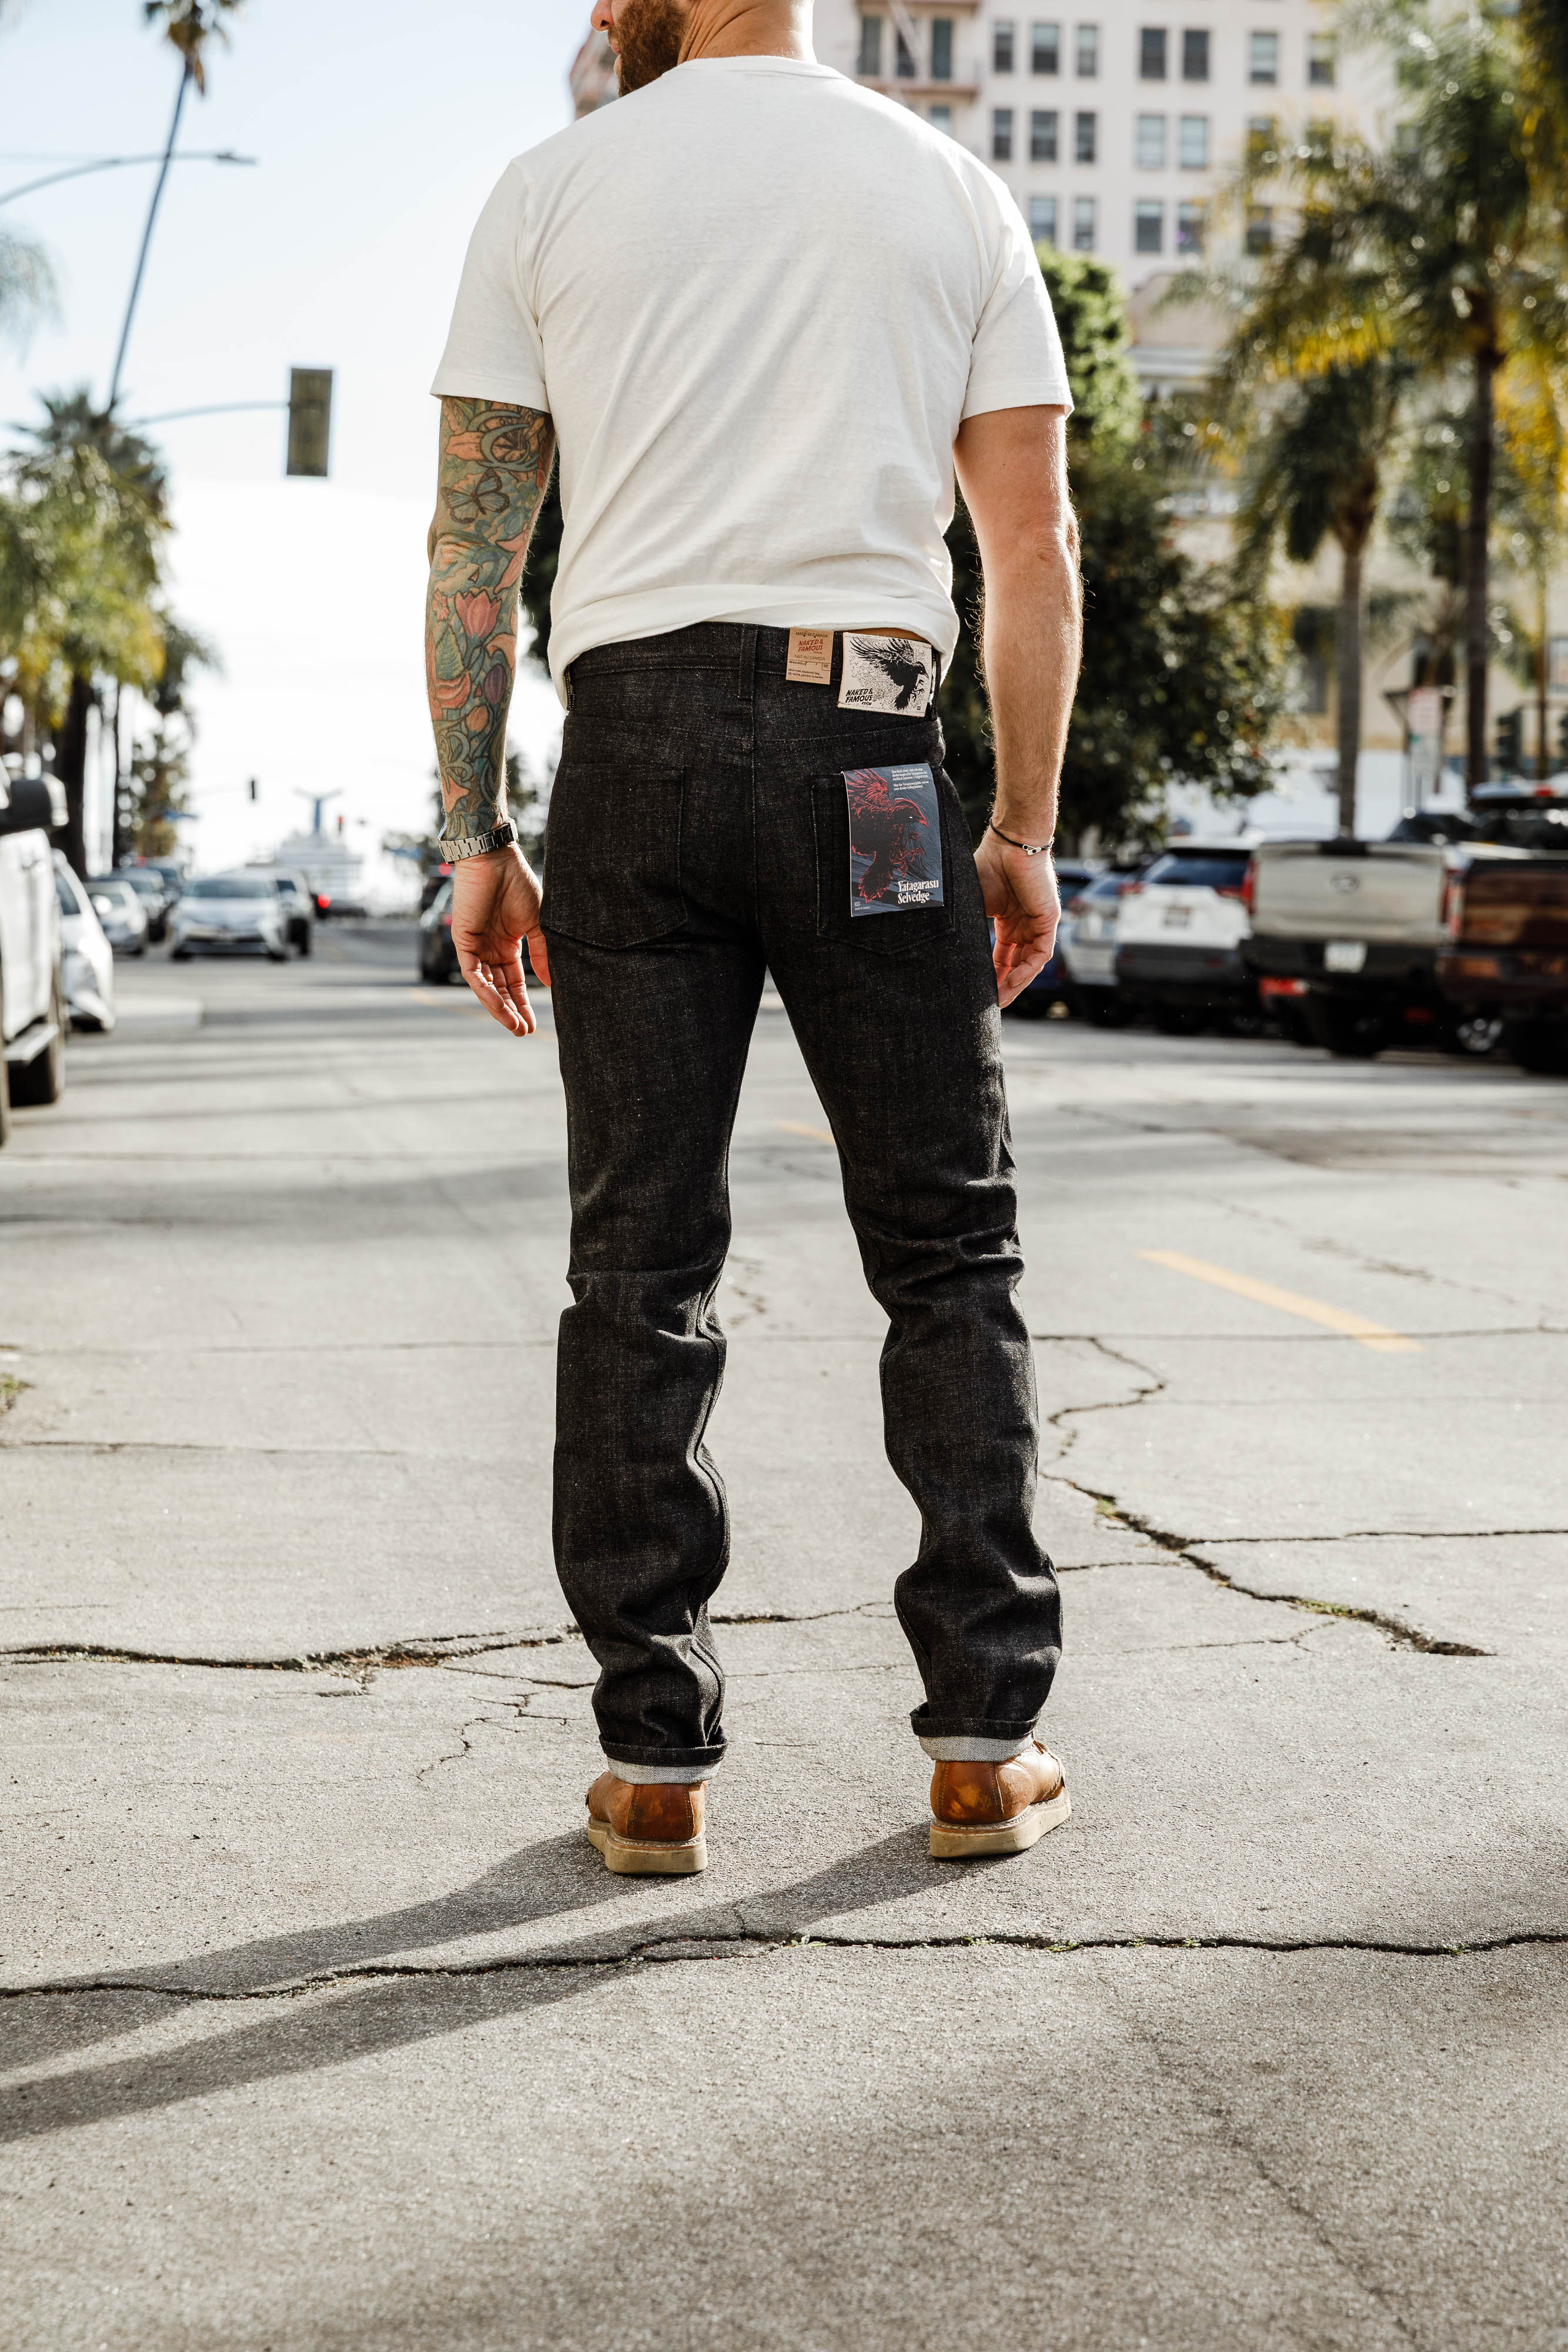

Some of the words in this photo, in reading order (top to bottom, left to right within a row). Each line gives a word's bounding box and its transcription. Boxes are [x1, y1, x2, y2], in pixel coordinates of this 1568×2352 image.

[845, 694, 873, 703] FAMOUS
[898, 880, 939, 893] Yatagarasu
[898, 890, 930, 904] Selvedge
